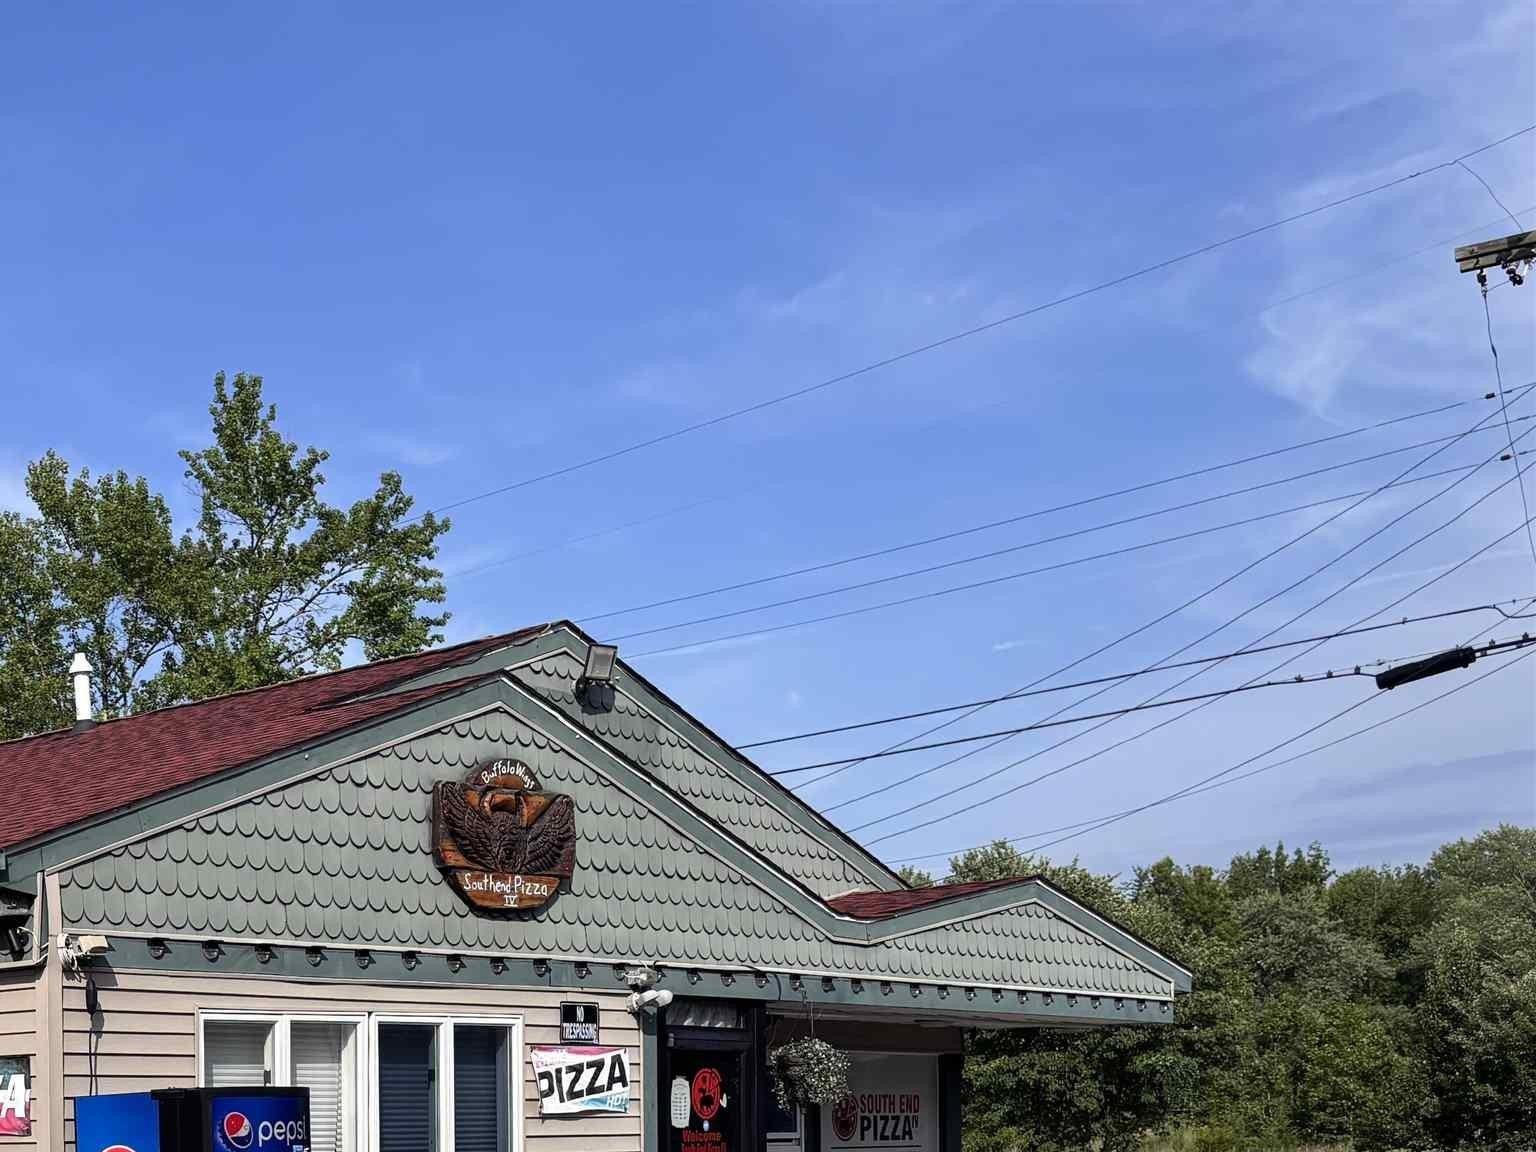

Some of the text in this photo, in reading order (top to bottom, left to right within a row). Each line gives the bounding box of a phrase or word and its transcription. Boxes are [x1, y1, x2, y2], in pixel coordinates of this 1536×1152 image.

[481, 760, 514, 784] Buffalo
[514, 876, 548, 896] Pizza
[503, 895, 518, 907] IV
[576, 1005, 584, 1022] NO
[563, 1022, 598, 1039] TRESPASSING
[537, 1053, 629, 1103] PIZZA
[860, 1093, 919, 1114] SOUTH END
[259, 1116, 306, 1147] pepsi
[682, 1129, 721, 1142] Welcome
[860, 1115, 913, 1141] PIZZA
